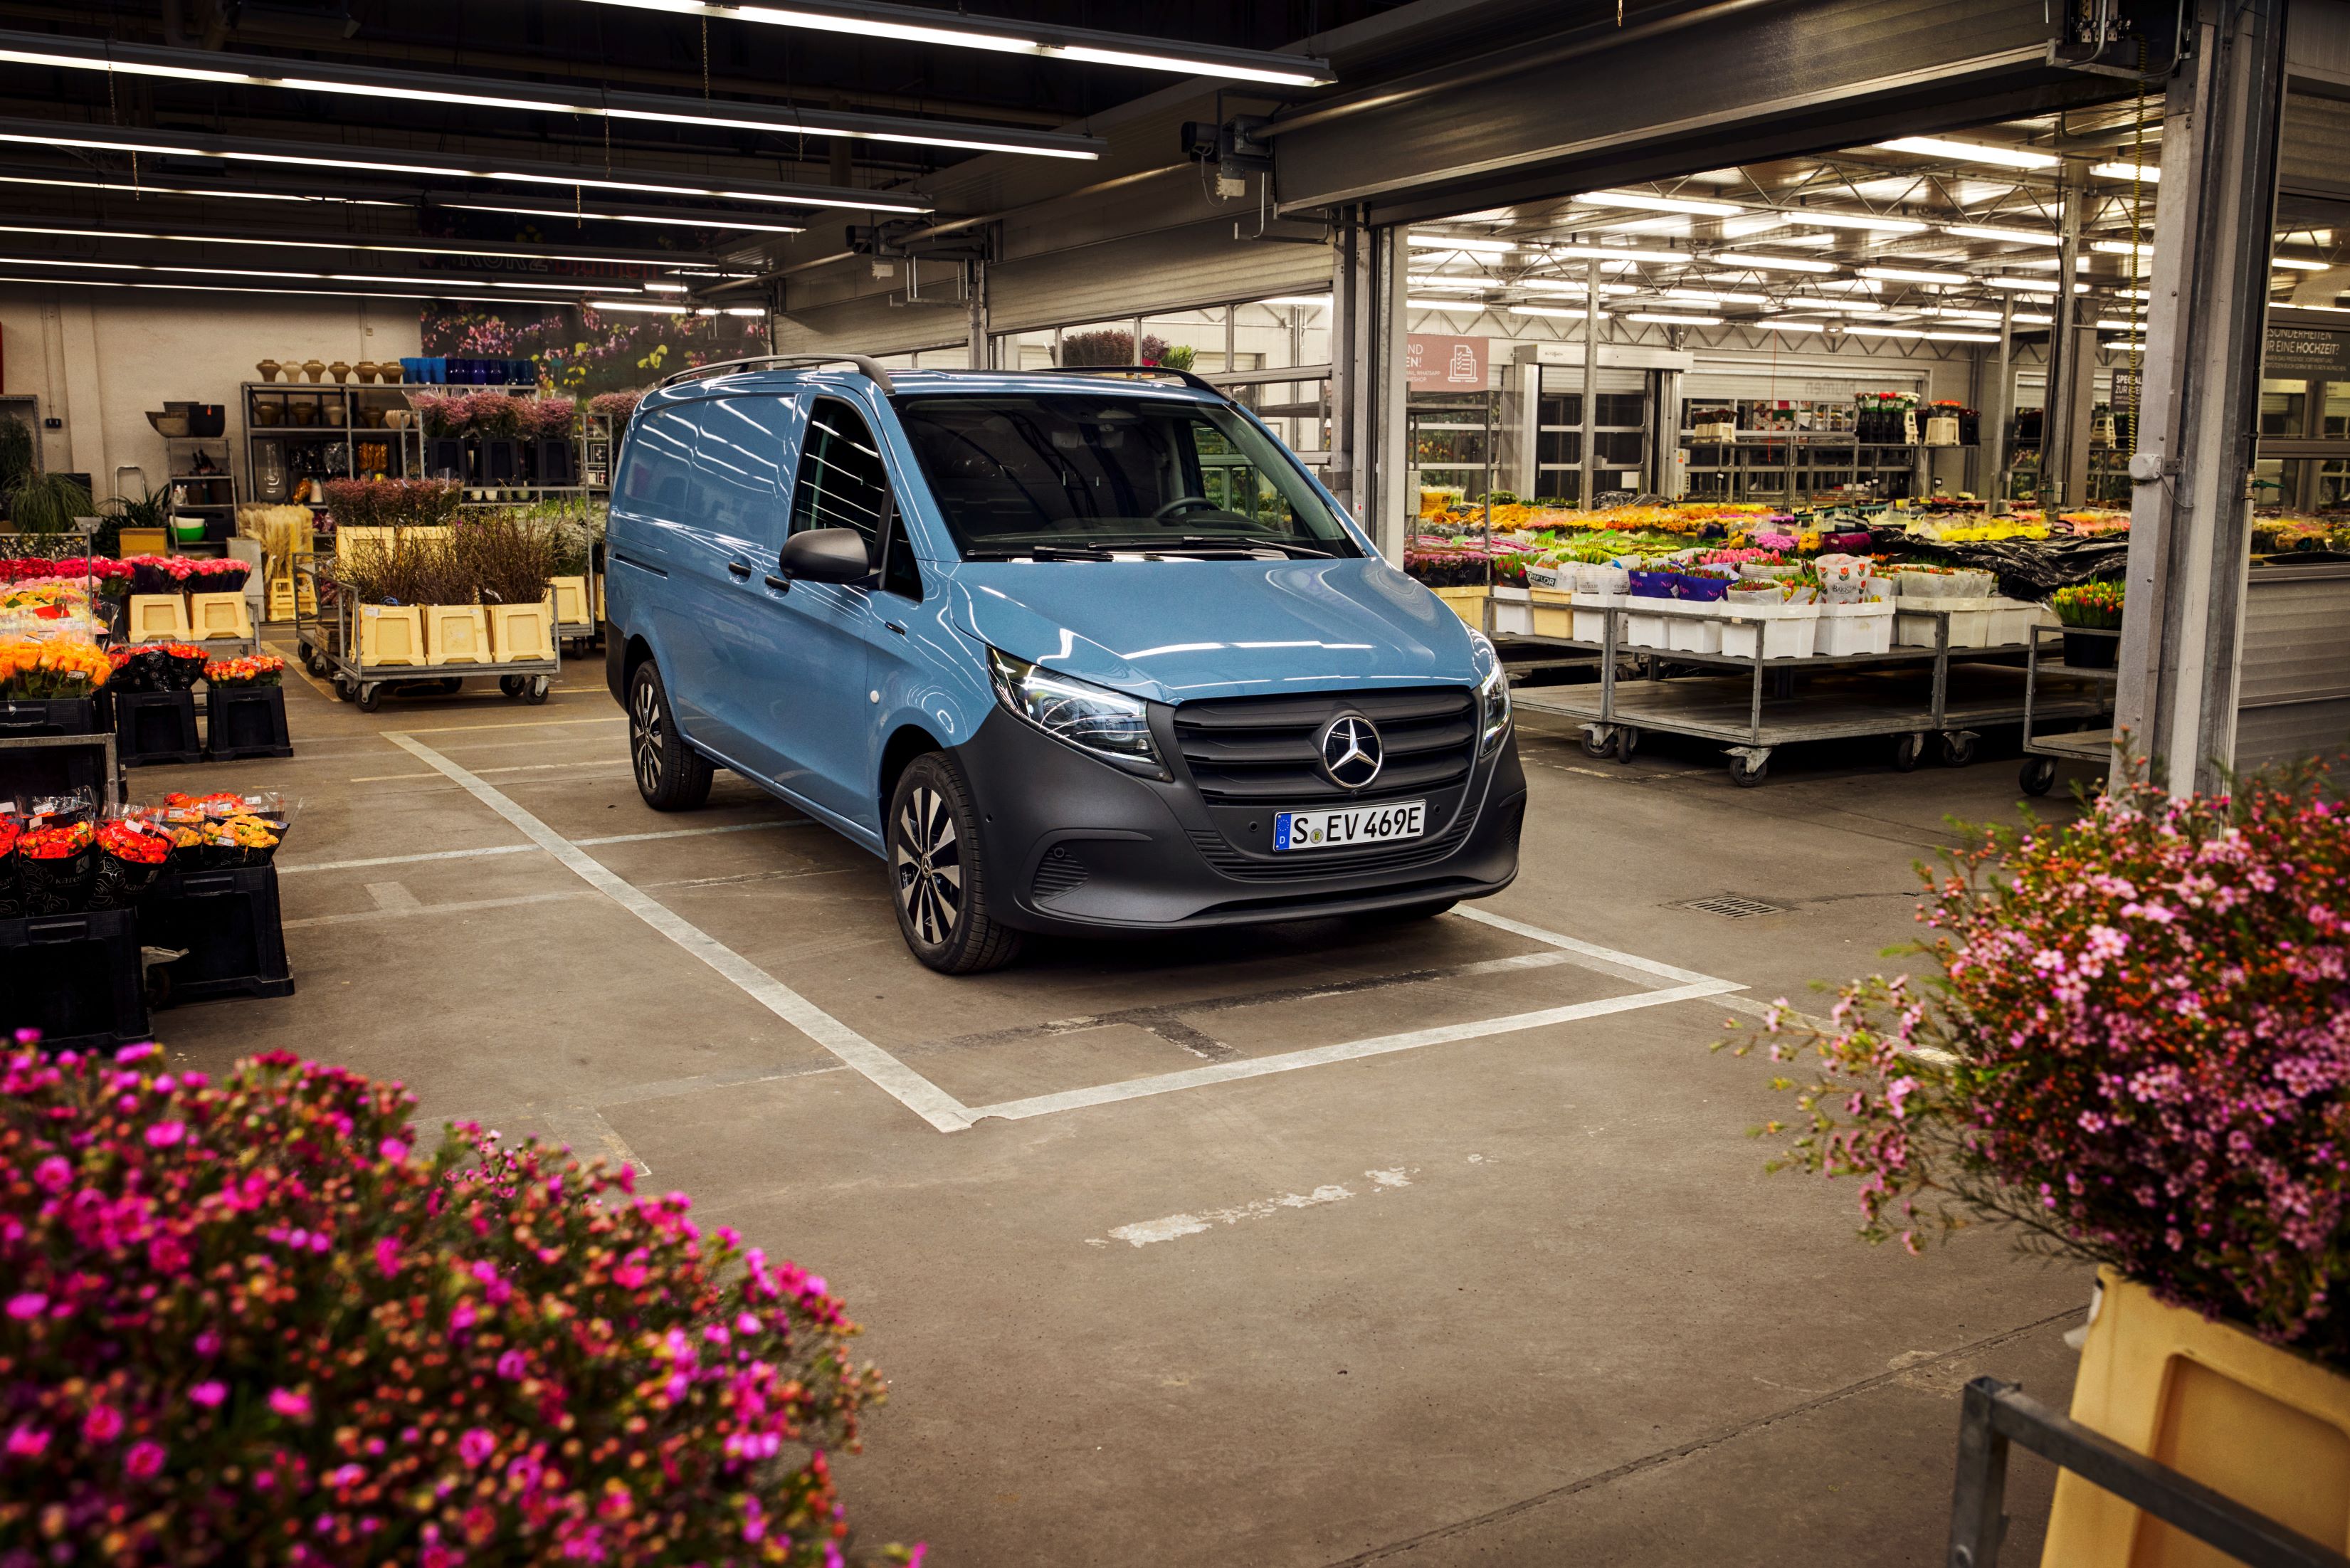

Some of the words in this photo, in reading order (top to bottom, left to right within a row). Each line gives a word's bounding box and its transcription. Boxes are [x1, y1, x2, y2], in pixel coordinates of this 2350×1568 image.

[2267, 329, 2333, 340] ESONDERHEITEN
[1408, 344, 1423, 354] ND
[2277, 342, 2295, 353] EINE
[2296, 342, 2340, 355] HOCHZEIT?
[2116, 374, 2142, 384] SPECAL
[1292, 818, 1308, 843] S
[1327, 814, 1359, 841] EV
[1364, 806, 1421, 838] 469E
[1280, 836, 1285, 844] D
